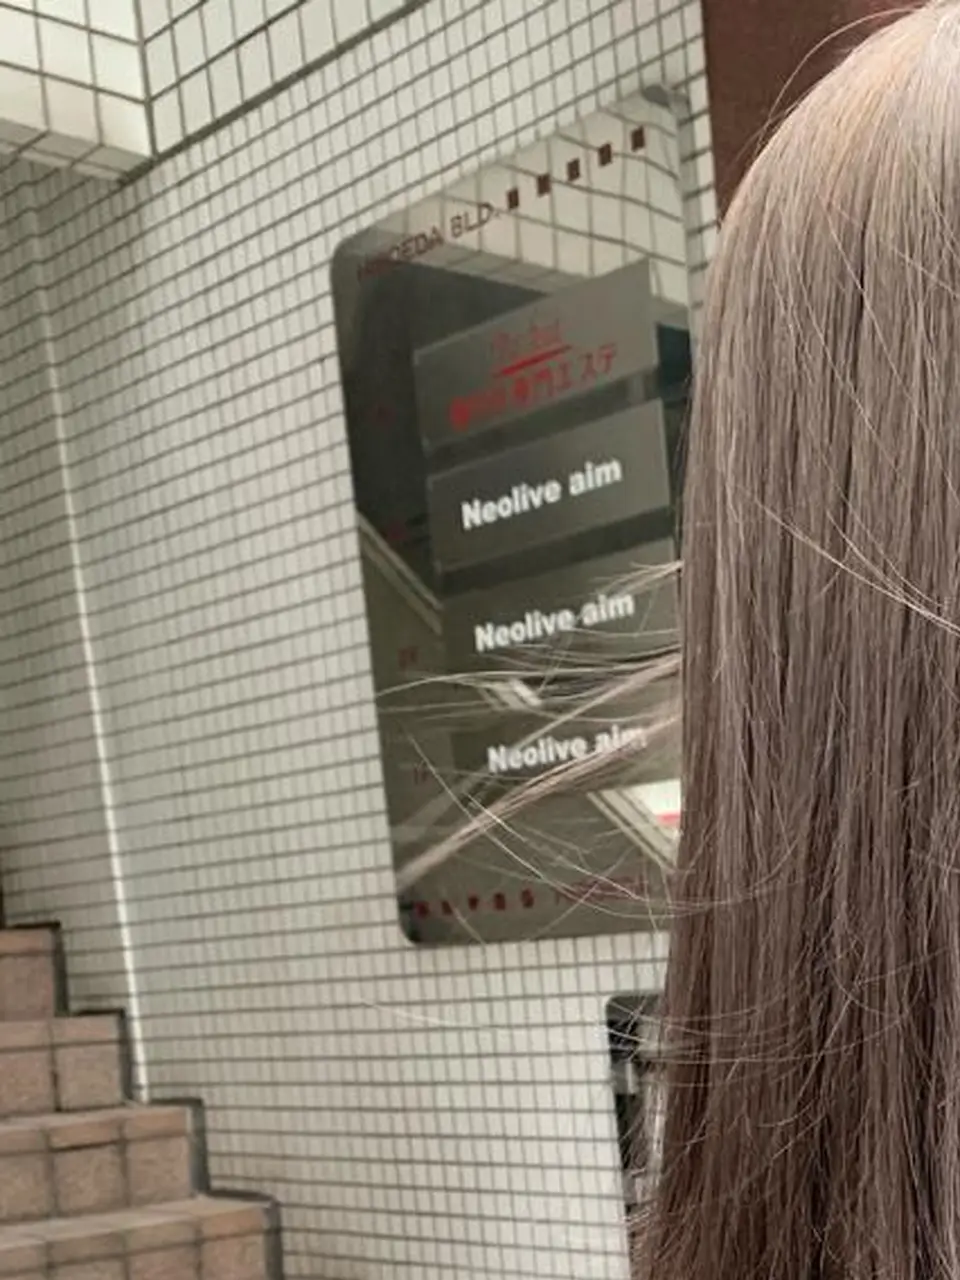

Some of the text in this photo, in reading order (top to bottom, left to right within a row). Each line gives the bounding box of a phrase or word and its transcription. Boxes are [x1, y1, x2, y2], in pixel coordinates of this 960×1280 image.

[461, 459, 622, 530] Neolive aim
[474, 593, 635, 653] Neolive aim
[487, 736, 588, 773] Neolive
